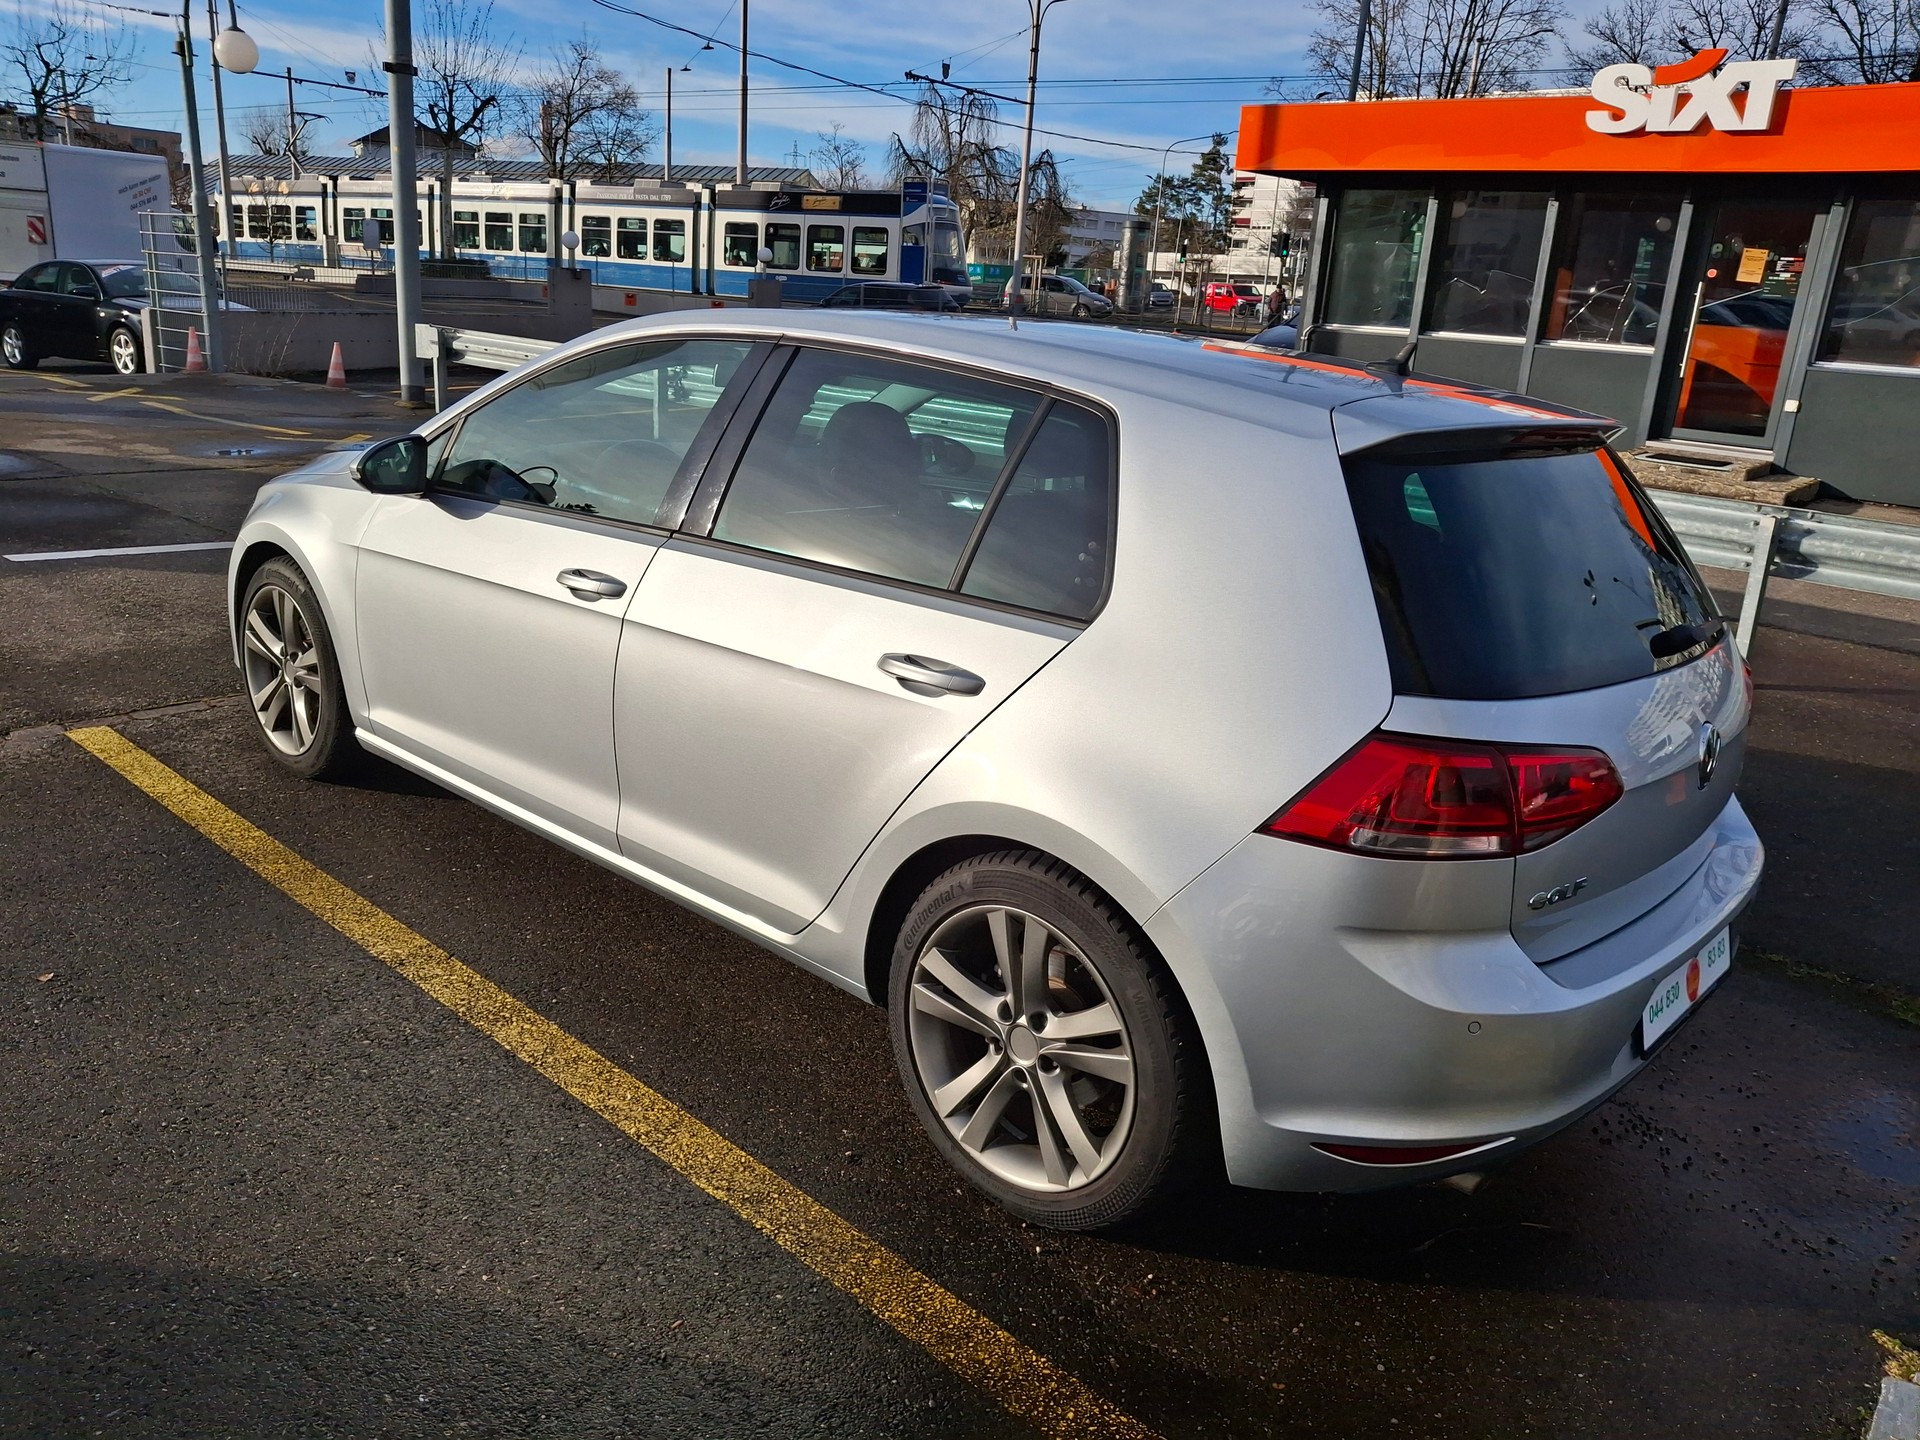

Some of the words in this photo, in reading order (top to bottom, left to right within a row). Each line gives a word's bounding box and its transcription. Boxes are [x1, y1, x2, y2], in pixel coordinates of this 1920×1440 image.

[903, 884, 957, 951] Continental
[1527, 876, 1588, 910] GOLF
[1648, 994, 1664, 1024] 044
[1665, 981, 1680, 1009] 830
[1707, 945, 1716, 968] 83
